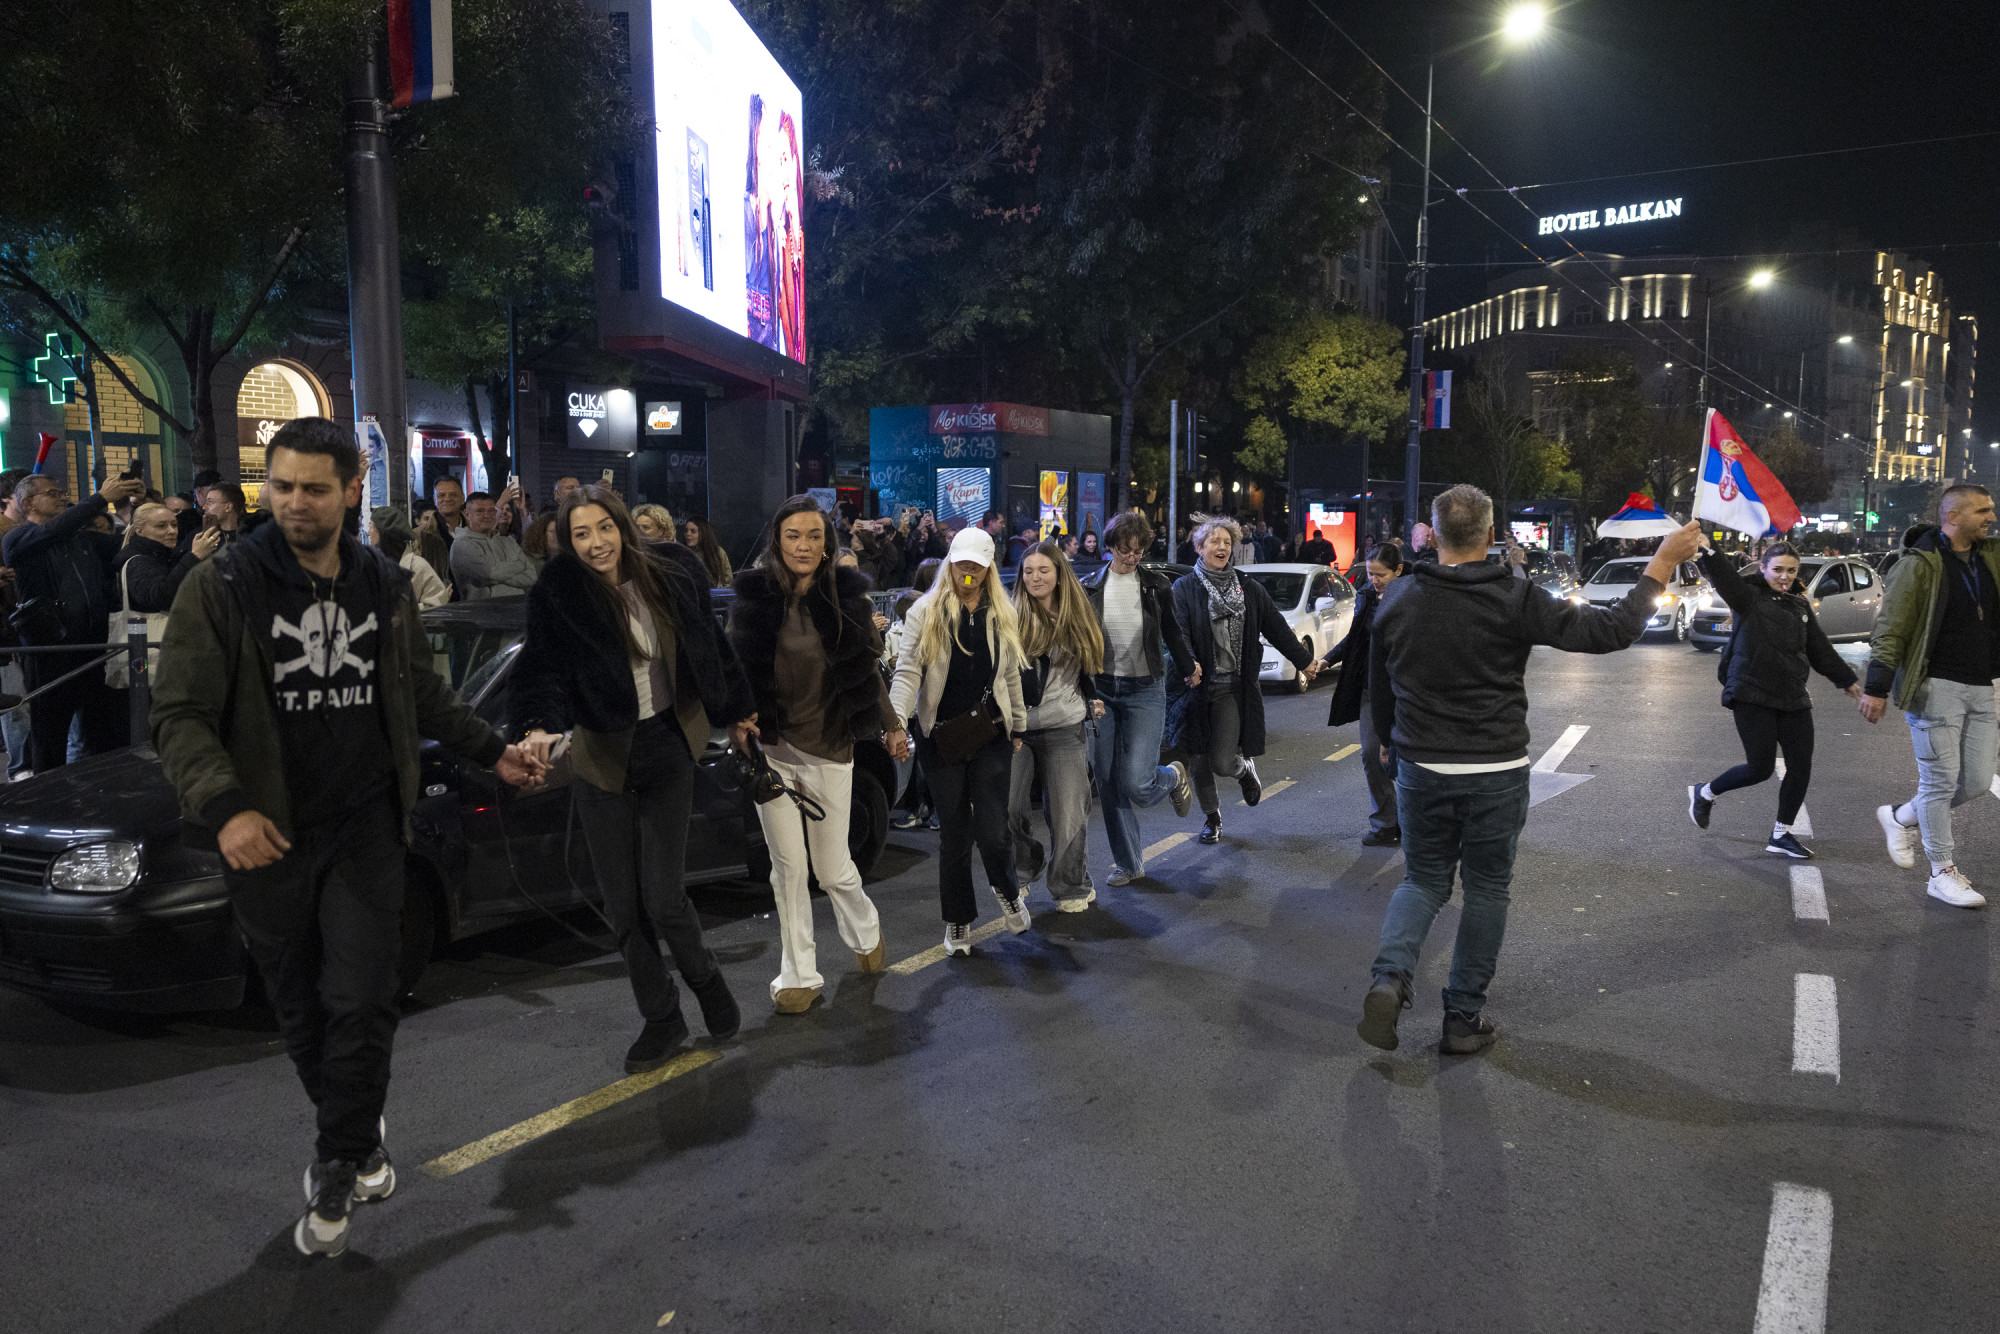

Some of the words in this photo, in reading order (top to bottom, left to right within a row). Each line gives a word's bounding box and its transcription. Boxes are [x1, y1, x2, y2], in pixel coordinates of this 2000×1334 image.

[1539, 210, 1600, 235] HOTEL
[1604, 198, 1682, 226] BALKAN
[568, 392, 606, 411] CUKA
[425, 438, 461, 449] ОПТИКА
[952, 486, 981, 502] Kapri
[307, 685, 373, 711] PAULI
